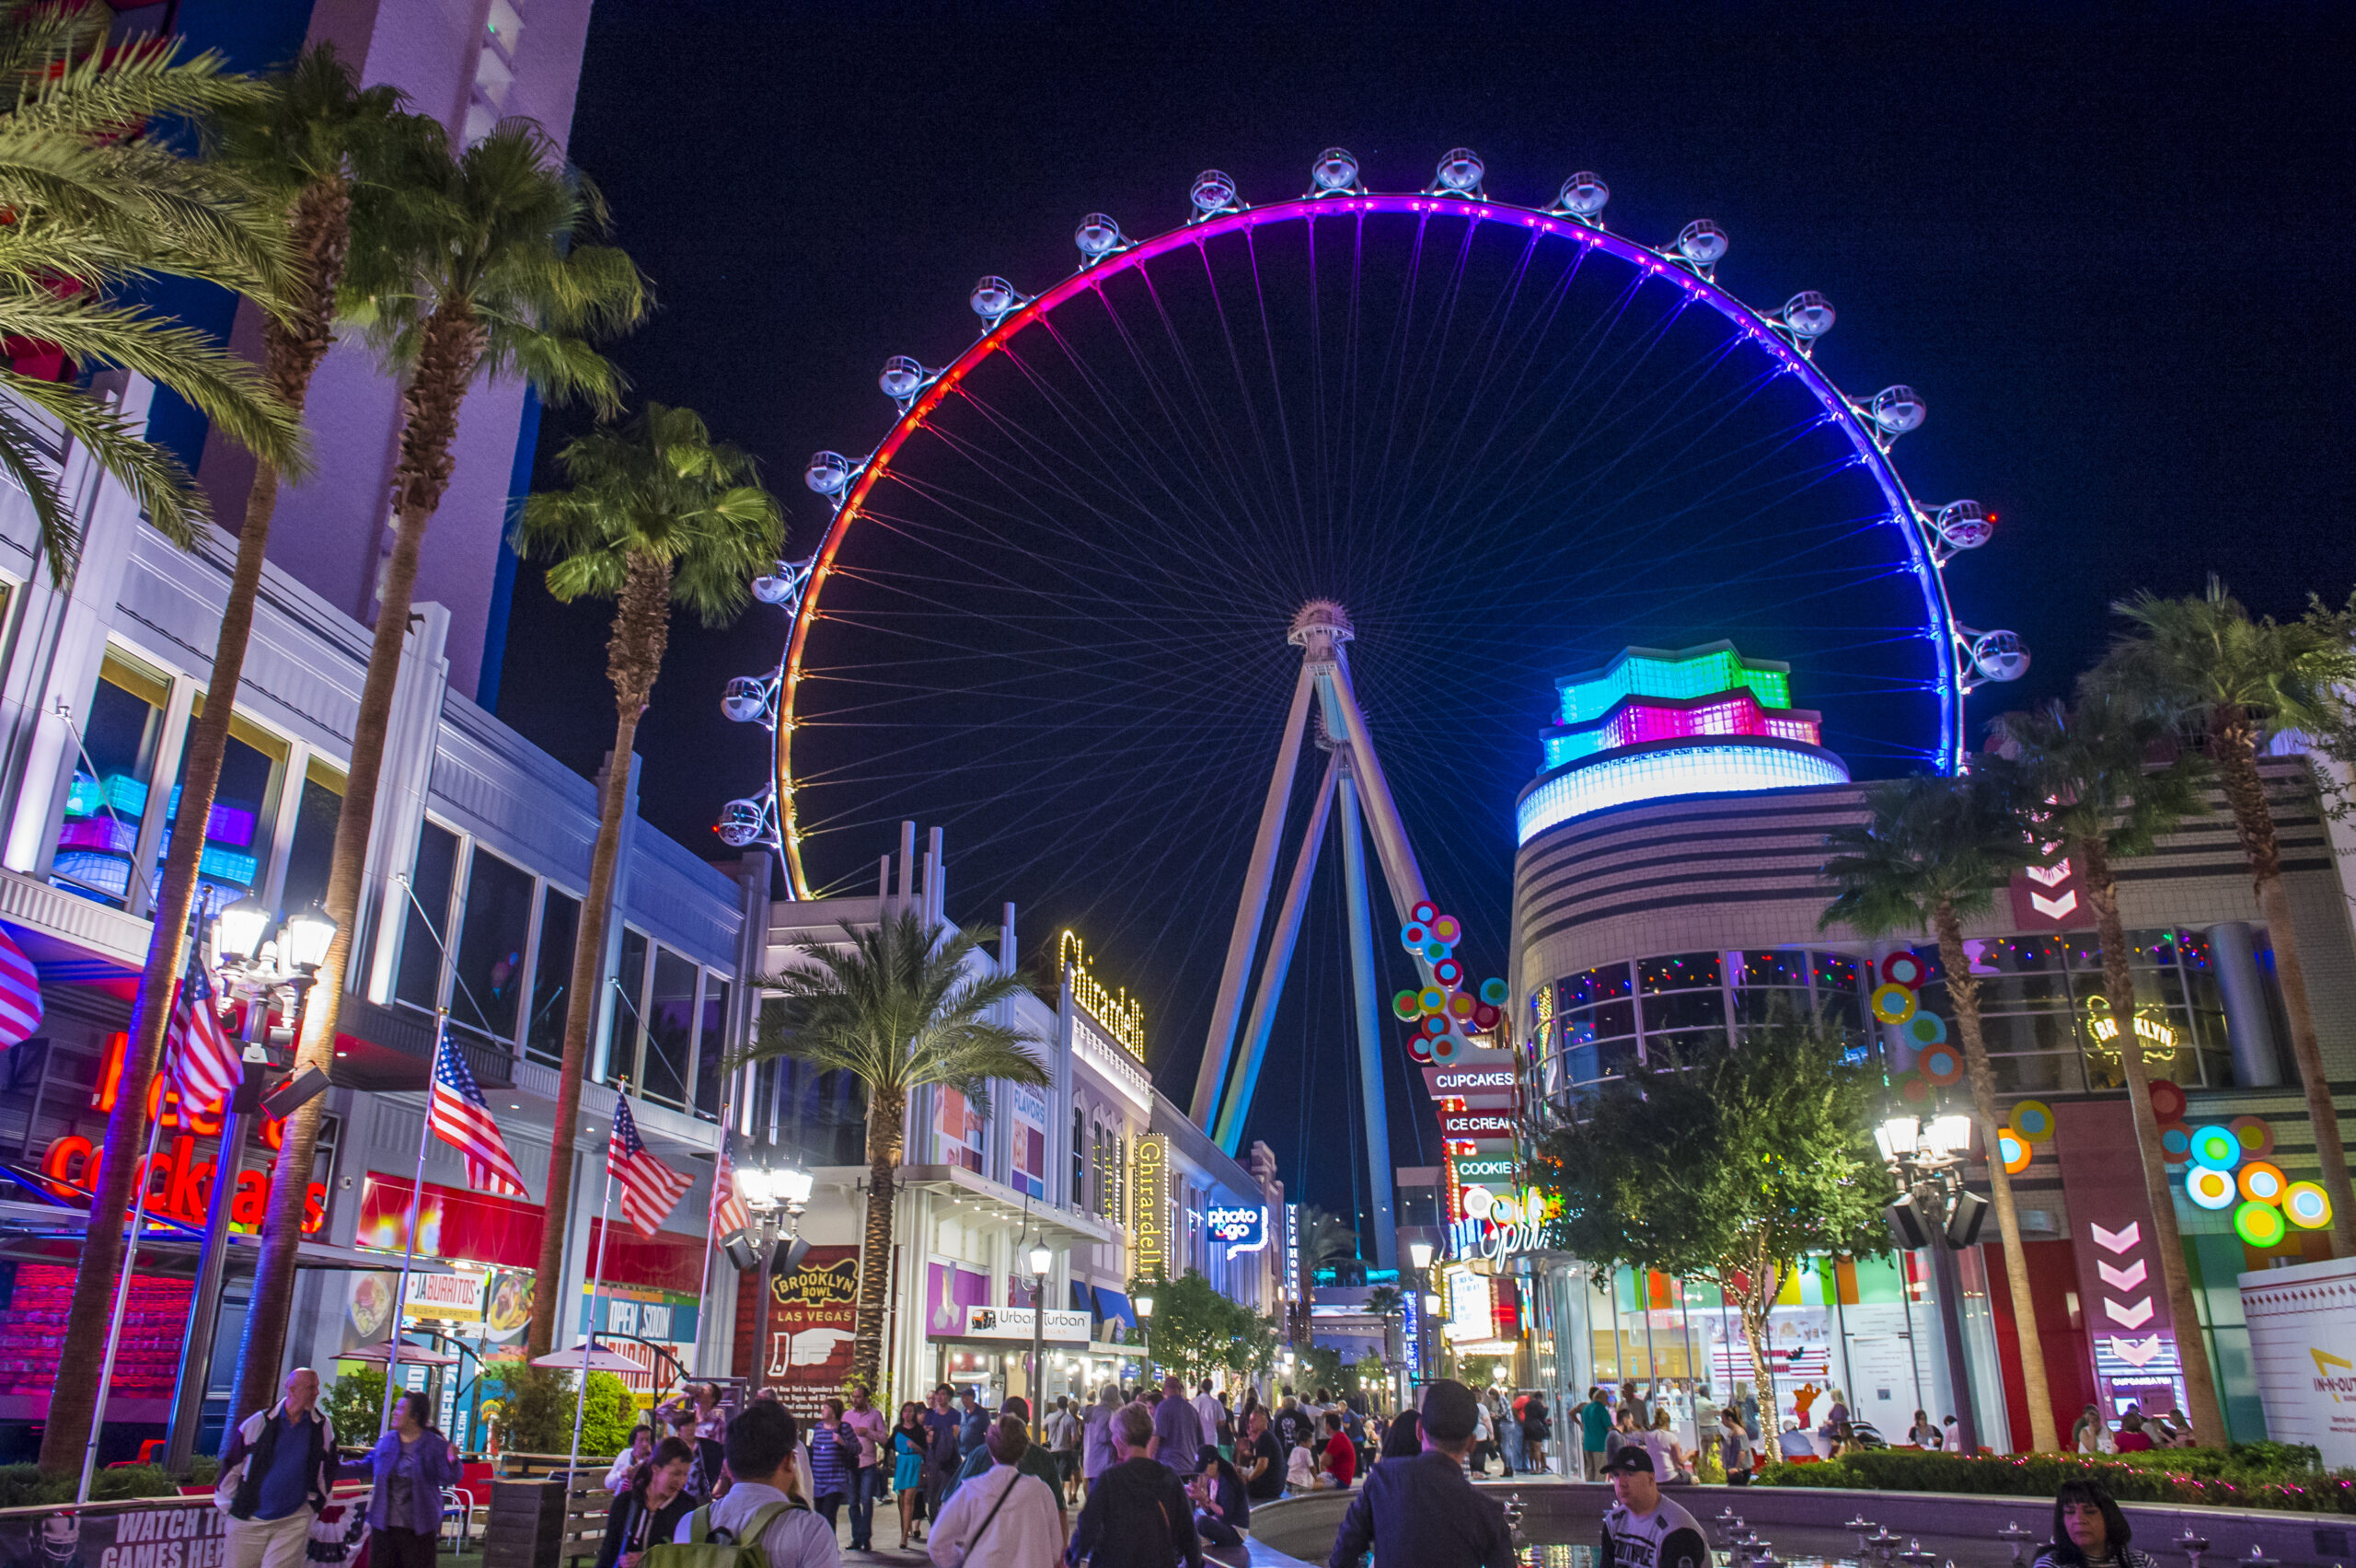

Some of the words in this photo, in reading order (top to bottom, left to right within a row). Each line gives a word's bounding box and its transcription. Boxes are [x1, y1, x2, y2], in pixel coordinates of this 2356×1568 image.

[2094, 1017, 2173, 1047] BRKLYN
[1436, 1072, 1514, 1088] CUPCAKES
[1014, 1089, 1045, 1124] FLAVORS
[1446, 1118, 1469, 1132] ICE
[1459, 1161, 1520, 1176] COOKIES
[1139, 1142, 1162, 1274] Ghirardelli
[1207, 1206, 1258, 1228] photo
[1288, 1204, 1299, 1246] Yard
[779, 1273, 855, 1294] BROOKLYN
[1288, 1248, 1299, 1300] House
[414, 1273, 477, 1305] JABURRITOS
[802, 1287, 834, 1297] BOWL
[438, 1309, 474, 1320] BURRITOS
[608, 1300, 640, 1336] OPEN
[641, 1304, 671, 1339] SOON
[778, 1311, 803, 1322] LAS
[807, 1311, 852, 1322] VEGAS
[1043, 1312, 1085, 1327] Turban
[1044, 1327, 1068, 1335] EGAS
[116, 1509, 201, 1544] WATCH
[205, 1506, 226, 1537] TH
[99, 1540, 184, 1568] GAMES
[187, 1538, 226, 1568] HER
